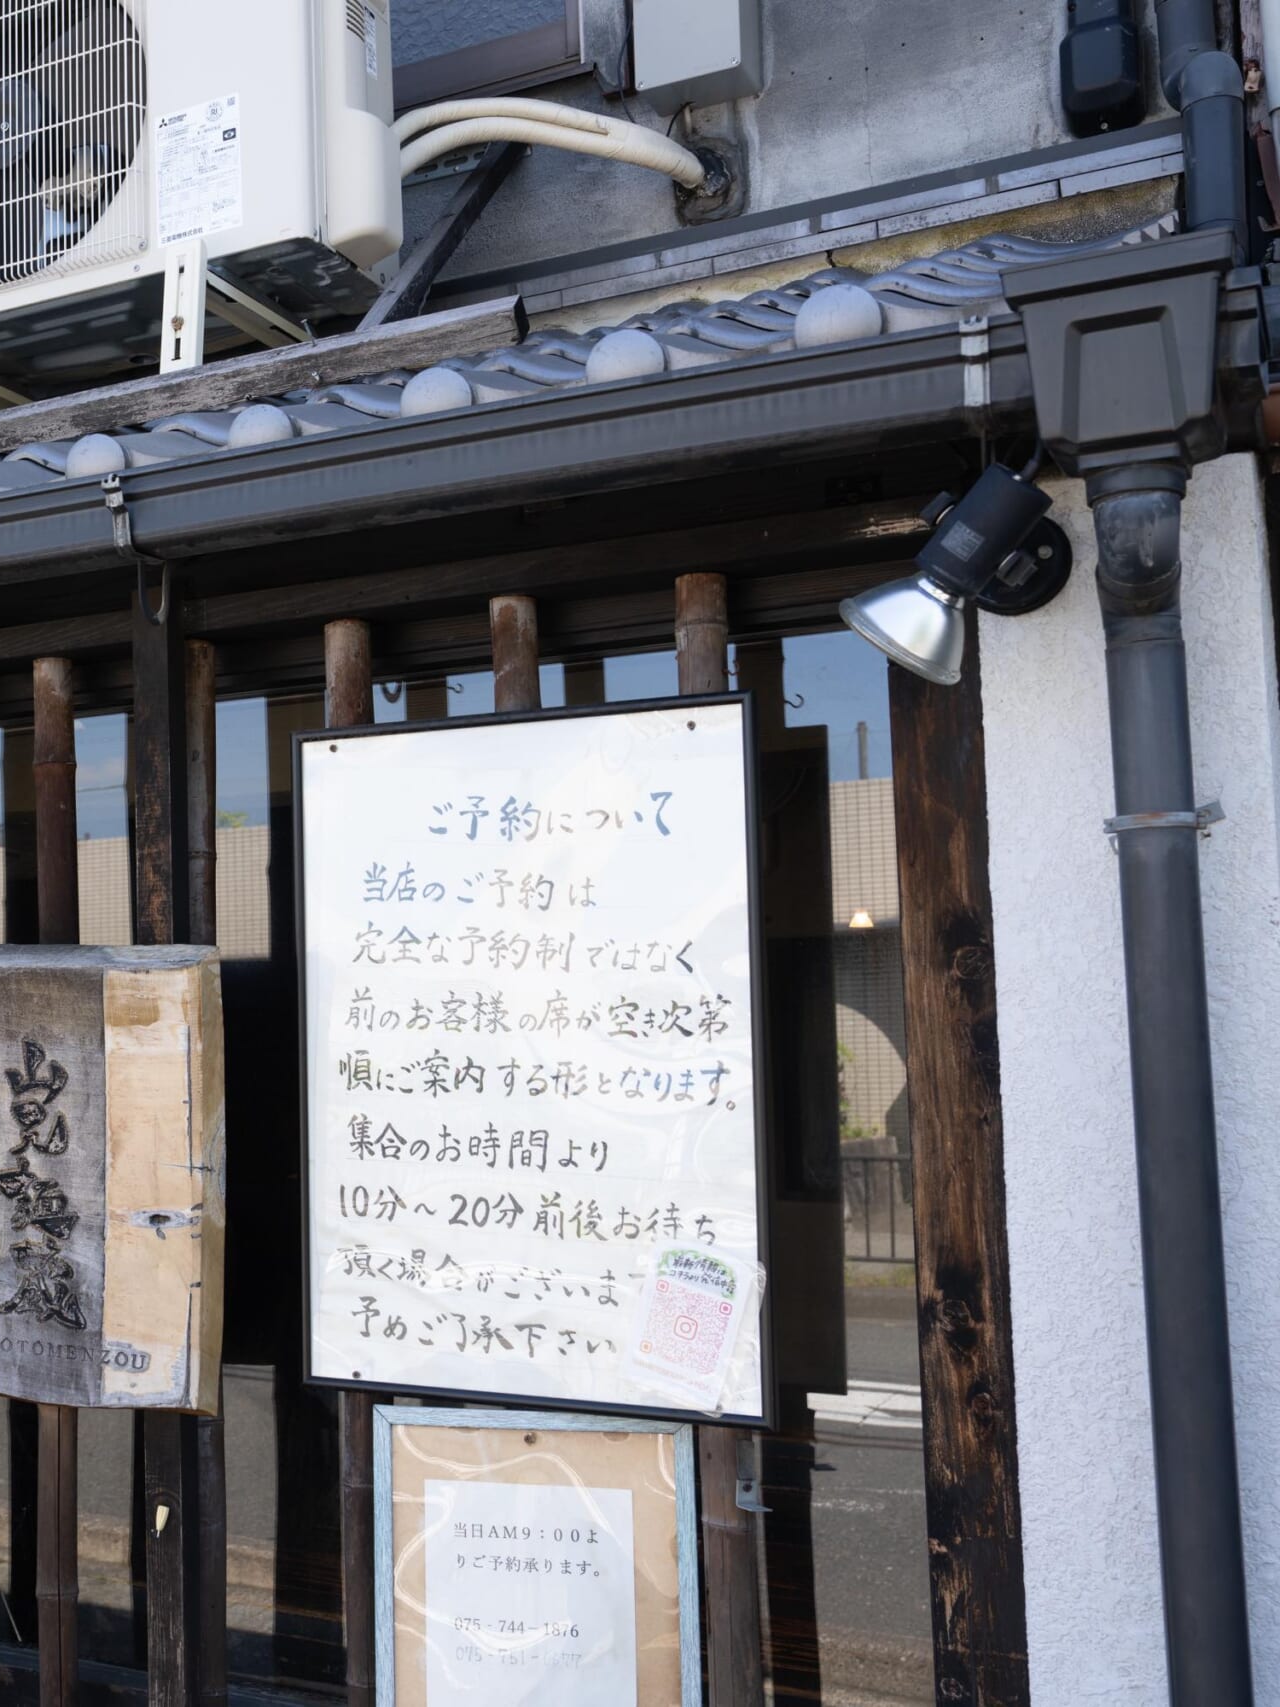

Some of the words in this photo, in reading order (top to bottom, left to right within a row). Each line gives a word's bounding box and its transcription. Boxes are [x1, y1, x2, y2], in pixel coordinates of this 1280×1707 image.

[428, 791, 673, 842] ご予約について
[362, 861, 597, 912] 当店のご予約は
[352, 922, 694, 972] 完全な予約制ではなく
[344, 987, 733, 1043] 前のお客様の席が空き次第
[338, 1048, 736, 1112] 順にご案内する形となります。
[347, 1112, 609, 1172] 集合のお時間より
[351, 1296, 618, 1359] 予めご了承下さい
[456, 1554, 600, 1578] りご予約承ります。
